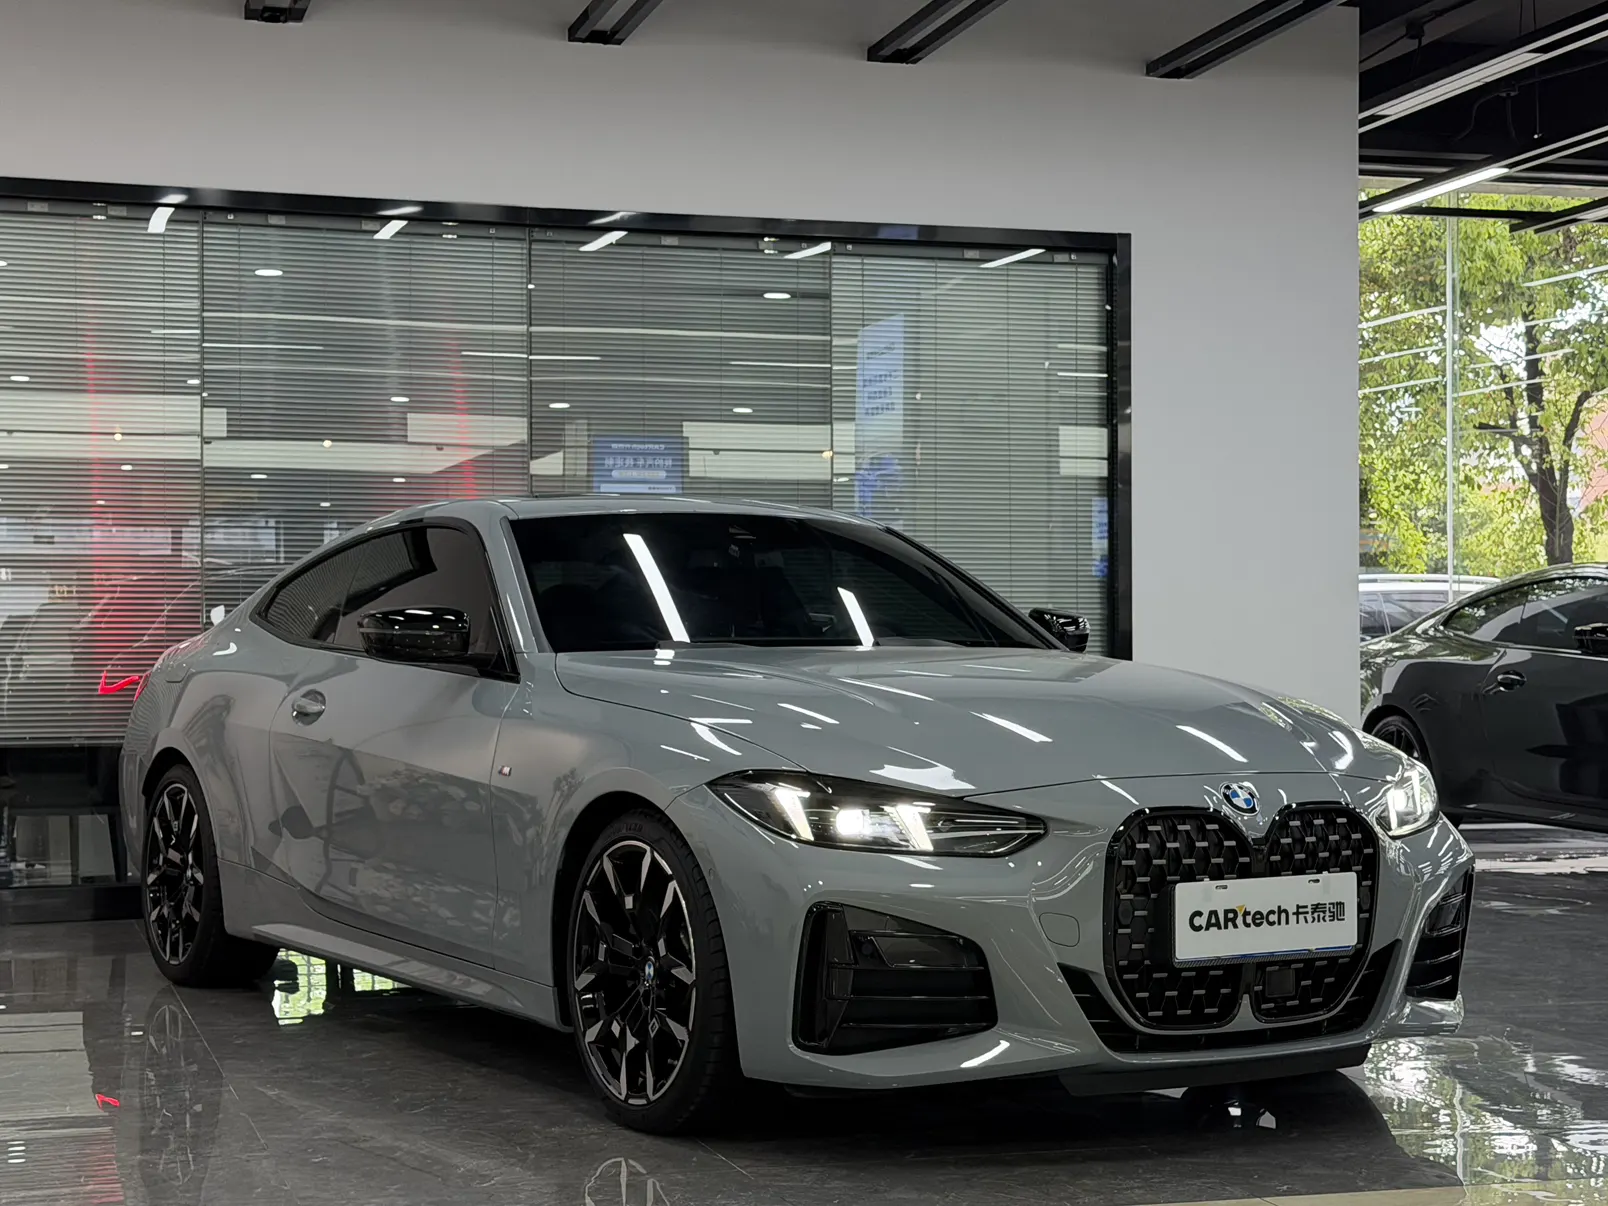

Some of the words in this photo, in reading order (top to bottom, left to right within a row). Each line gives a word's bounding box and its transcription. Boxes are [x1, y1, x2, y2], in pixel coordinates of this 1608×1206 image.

[1188, 904, 1290, 932] CARtech
[1292, 900, 1345, 925] 卡泰驰
